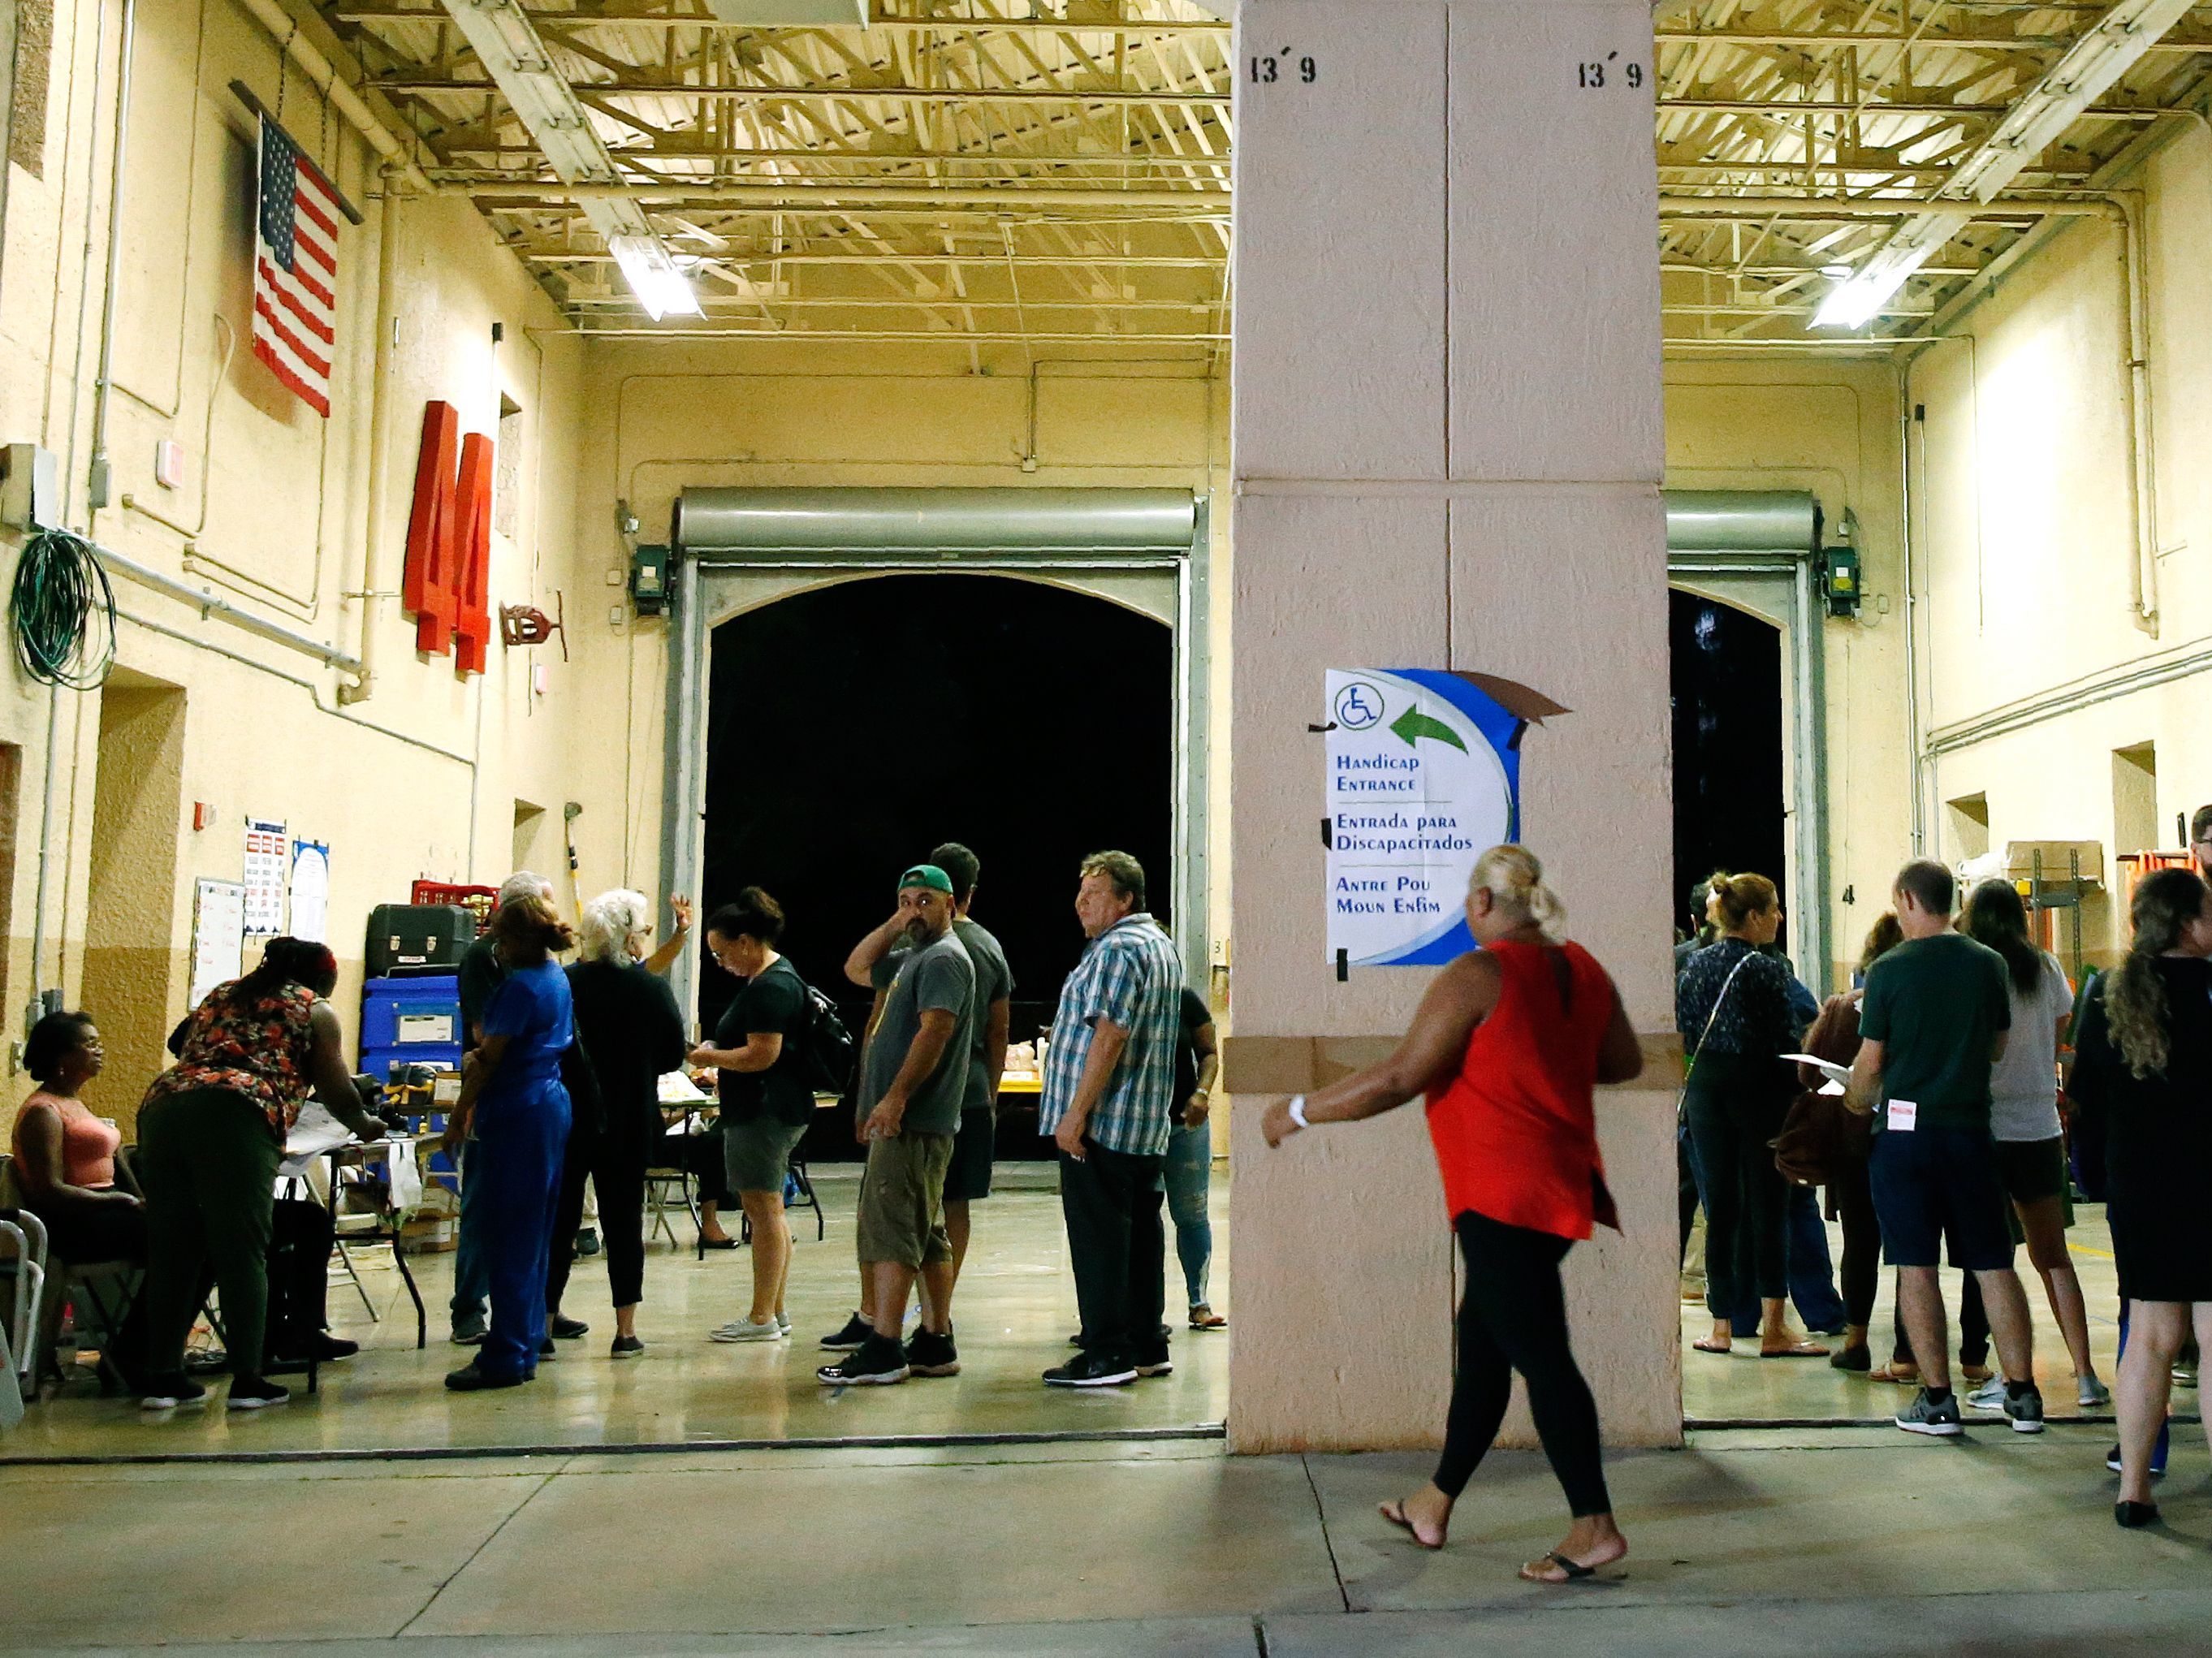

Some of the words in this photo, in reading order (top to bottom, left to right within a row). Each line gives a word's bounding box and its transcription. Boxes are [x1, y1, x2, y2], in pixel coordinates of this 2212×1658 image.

[1337, 753, 1419, 771] Handicap
[1337, 776, 1416, 792] Entrance
[1337, 813, 1409, 829] Entrada
[1417, 817, 1457, 831] para
[1337, 833, 1472, 853] Discapacitados
[1337, 877, 1388, 892] Antre
[1398, 876, 1431, 891] Pou
[1843, 884, 1855, 905] 4
[1337, 898, 1385, 913] Moun
[1214, 940, 1221, 953] 3
